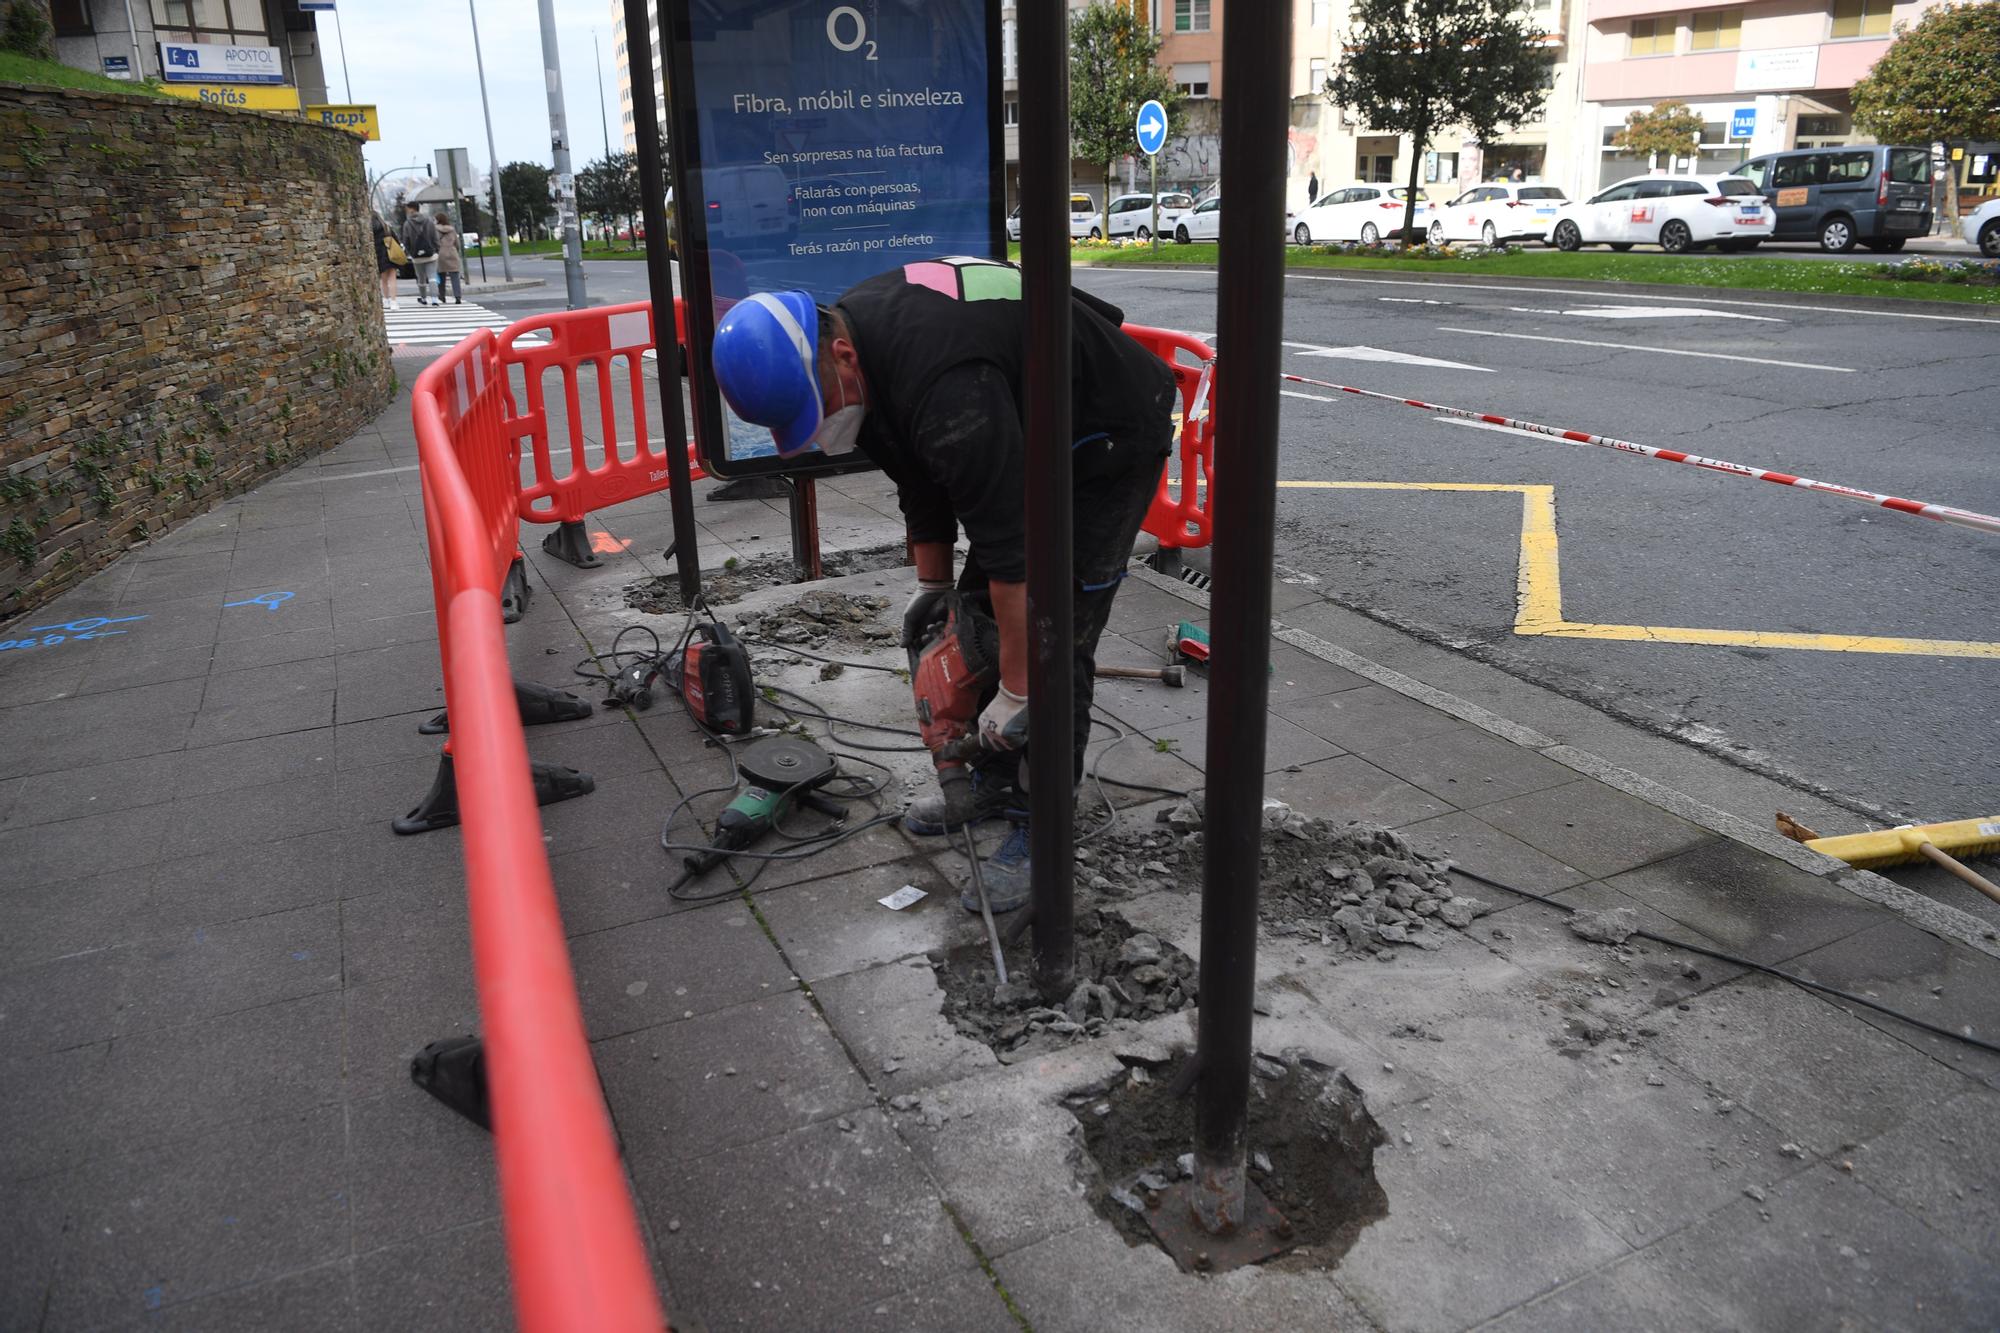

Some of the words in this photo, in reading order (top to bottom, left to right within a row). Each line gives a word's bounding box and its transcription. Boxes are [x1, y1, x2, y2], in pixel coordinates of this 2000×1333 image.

[225, 49, 273, 63] APOSTOL
[199, 88, 247, 104] Sofás
[733, 94, 793, 115] Fibra,
[798, 90, 855, 111] móbil
[860, 94, 873, 107] e
[878, 87, 964, 107] sinxeleza
[321, 110, 367, 127] Rapi
[1735, 117, 1755, 127] TAXI
[763, 152, 789, 165] Sen
[792, 149, 853, 165] sorpresas
[857, 149, 873, 159] na
[876, 145, 896, 157] túa
[899, 144, 944, 156] factura
[795, 185, 841, 200] Falarás
[844, 186, 867, 197] con
[870, 183, 921, 199] persoas,
[803, 206, 827, 217] non
[830, 204, 853, 216] con
[857, 200, 916, 217] máquinas
[788, 241, 823, 256] Terás
[826, 238, 860, 253] razón
[863, 239, 885, 253] por
[888, 233, 933, 249] defecto
